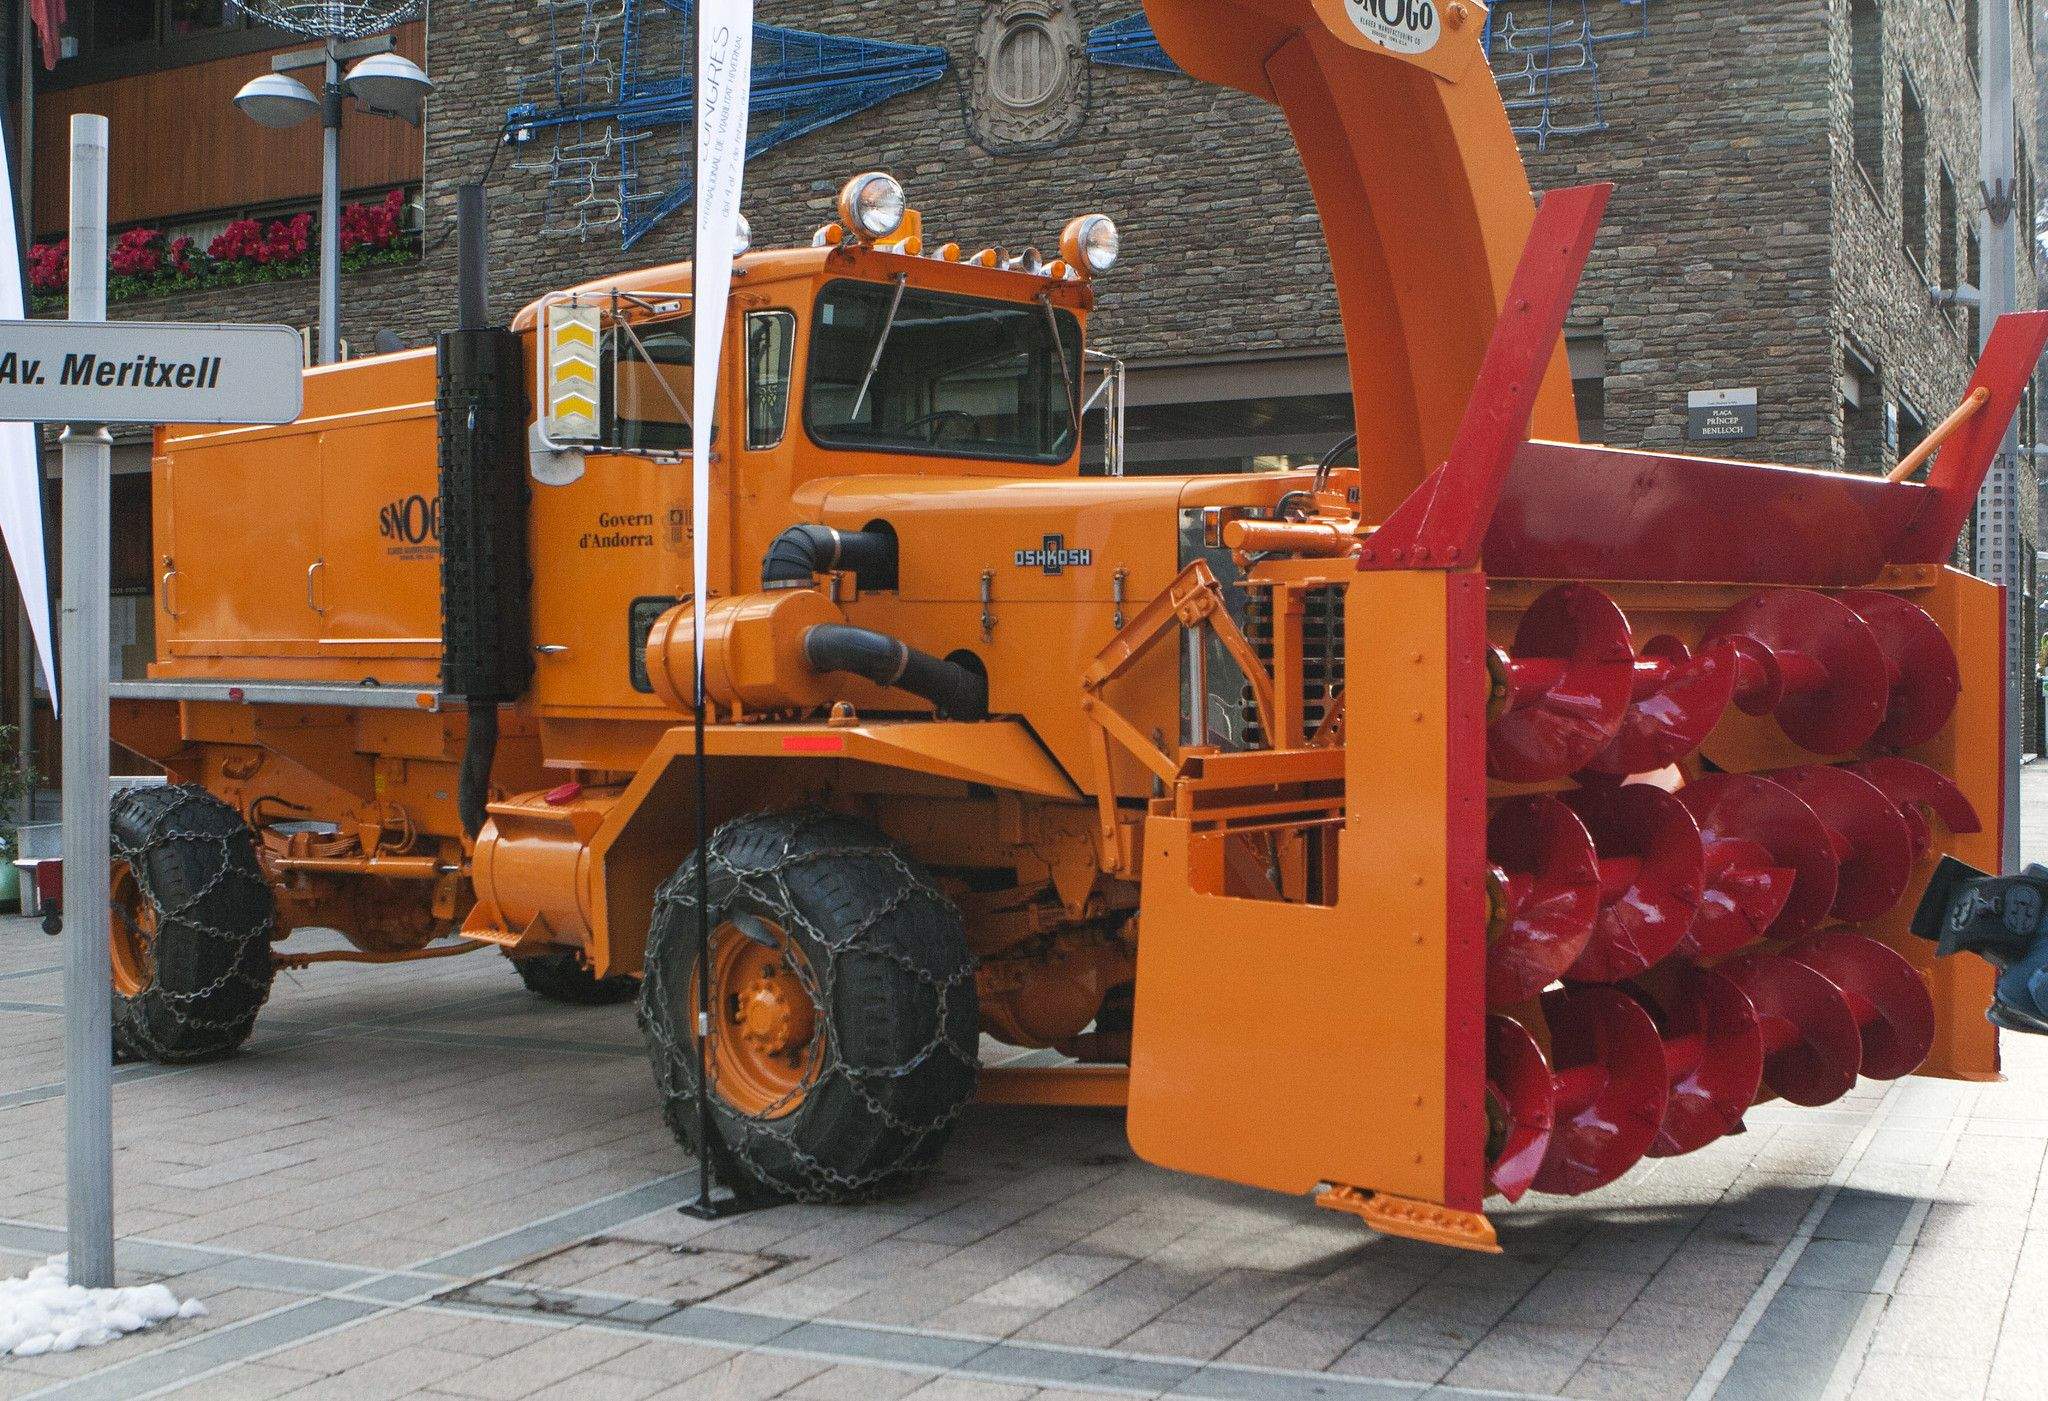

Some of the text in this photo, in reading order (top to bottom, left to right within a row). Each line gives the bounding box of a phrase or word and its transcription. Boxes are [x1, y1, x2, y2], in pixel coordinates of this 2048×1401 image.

[0, 352, 221, 388] Av. Meritxell
[1702, 426, 1743, 434] BENLLOCH
[599, 512, 653, 528] Govern
[579, 532, 654, 549] d'Andorra
[1014, 549, 1091, 567] OSHKOSH
